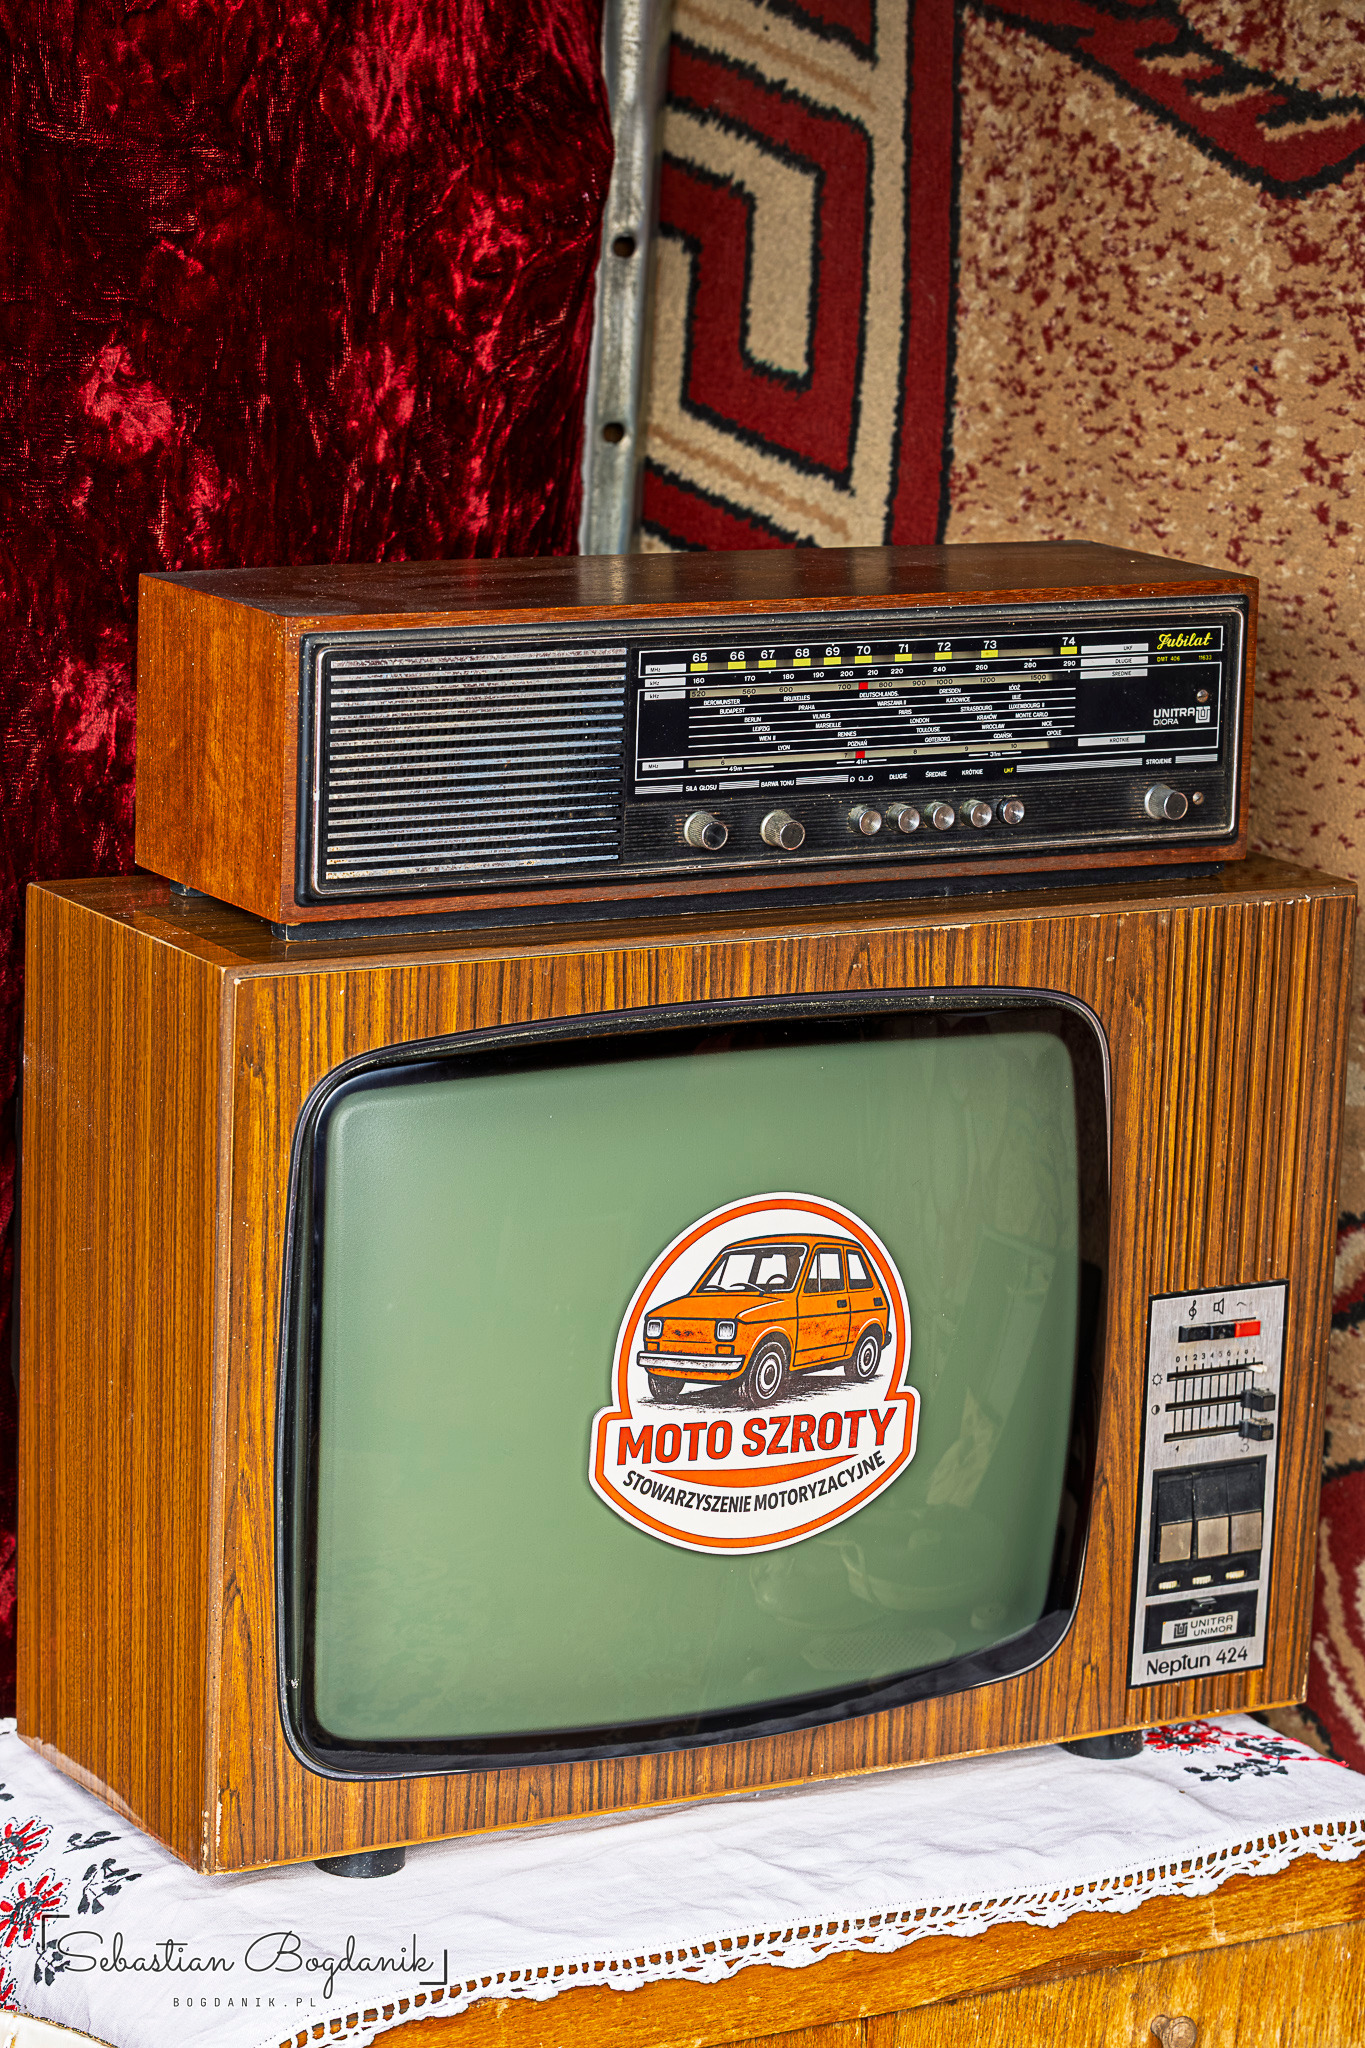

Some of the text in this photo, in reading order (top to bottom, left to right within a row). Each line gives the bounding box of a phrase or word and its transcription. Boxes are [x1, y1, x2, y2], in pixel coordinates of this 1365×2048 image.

[1156, 632, 1213, 650] Jubilat
[692, 652, 707, 662] 65
[729, 651, 745, 660] 66
[760, 649, 775, 659] 67
[795, 648, 810, 658] 68
[825, 646, 840, 656] 69
[856, 645, 871, 655] 70
[898, 643, 909, 653] 71
[937, 641, 952, 651] 72
[983, 640, 997, 649] 73
[1062, 636, 1076, 646] 74
[1008, 702, 1041, 710] LUXEMBOURG
[1153, 707, 1195, 718] UNITRA
[1153, 718, 1179, 726] DIORA
[925, 770, 948, 778] ŚREDNIE
[961, 768, 984, 776] KRÓTKIE
[616, 1406, 898, 1466] MOTO SZROTY
[623, 1449, 886, 1514] STOWARZYSZENIE MOTORYZACYJNE
[1190, 1614, 1234, 1629] UNITRA
[1193, 1624, 1233, 1637] UNIMOR
[1147, 1645, 1248, 1676] Neptun 424
